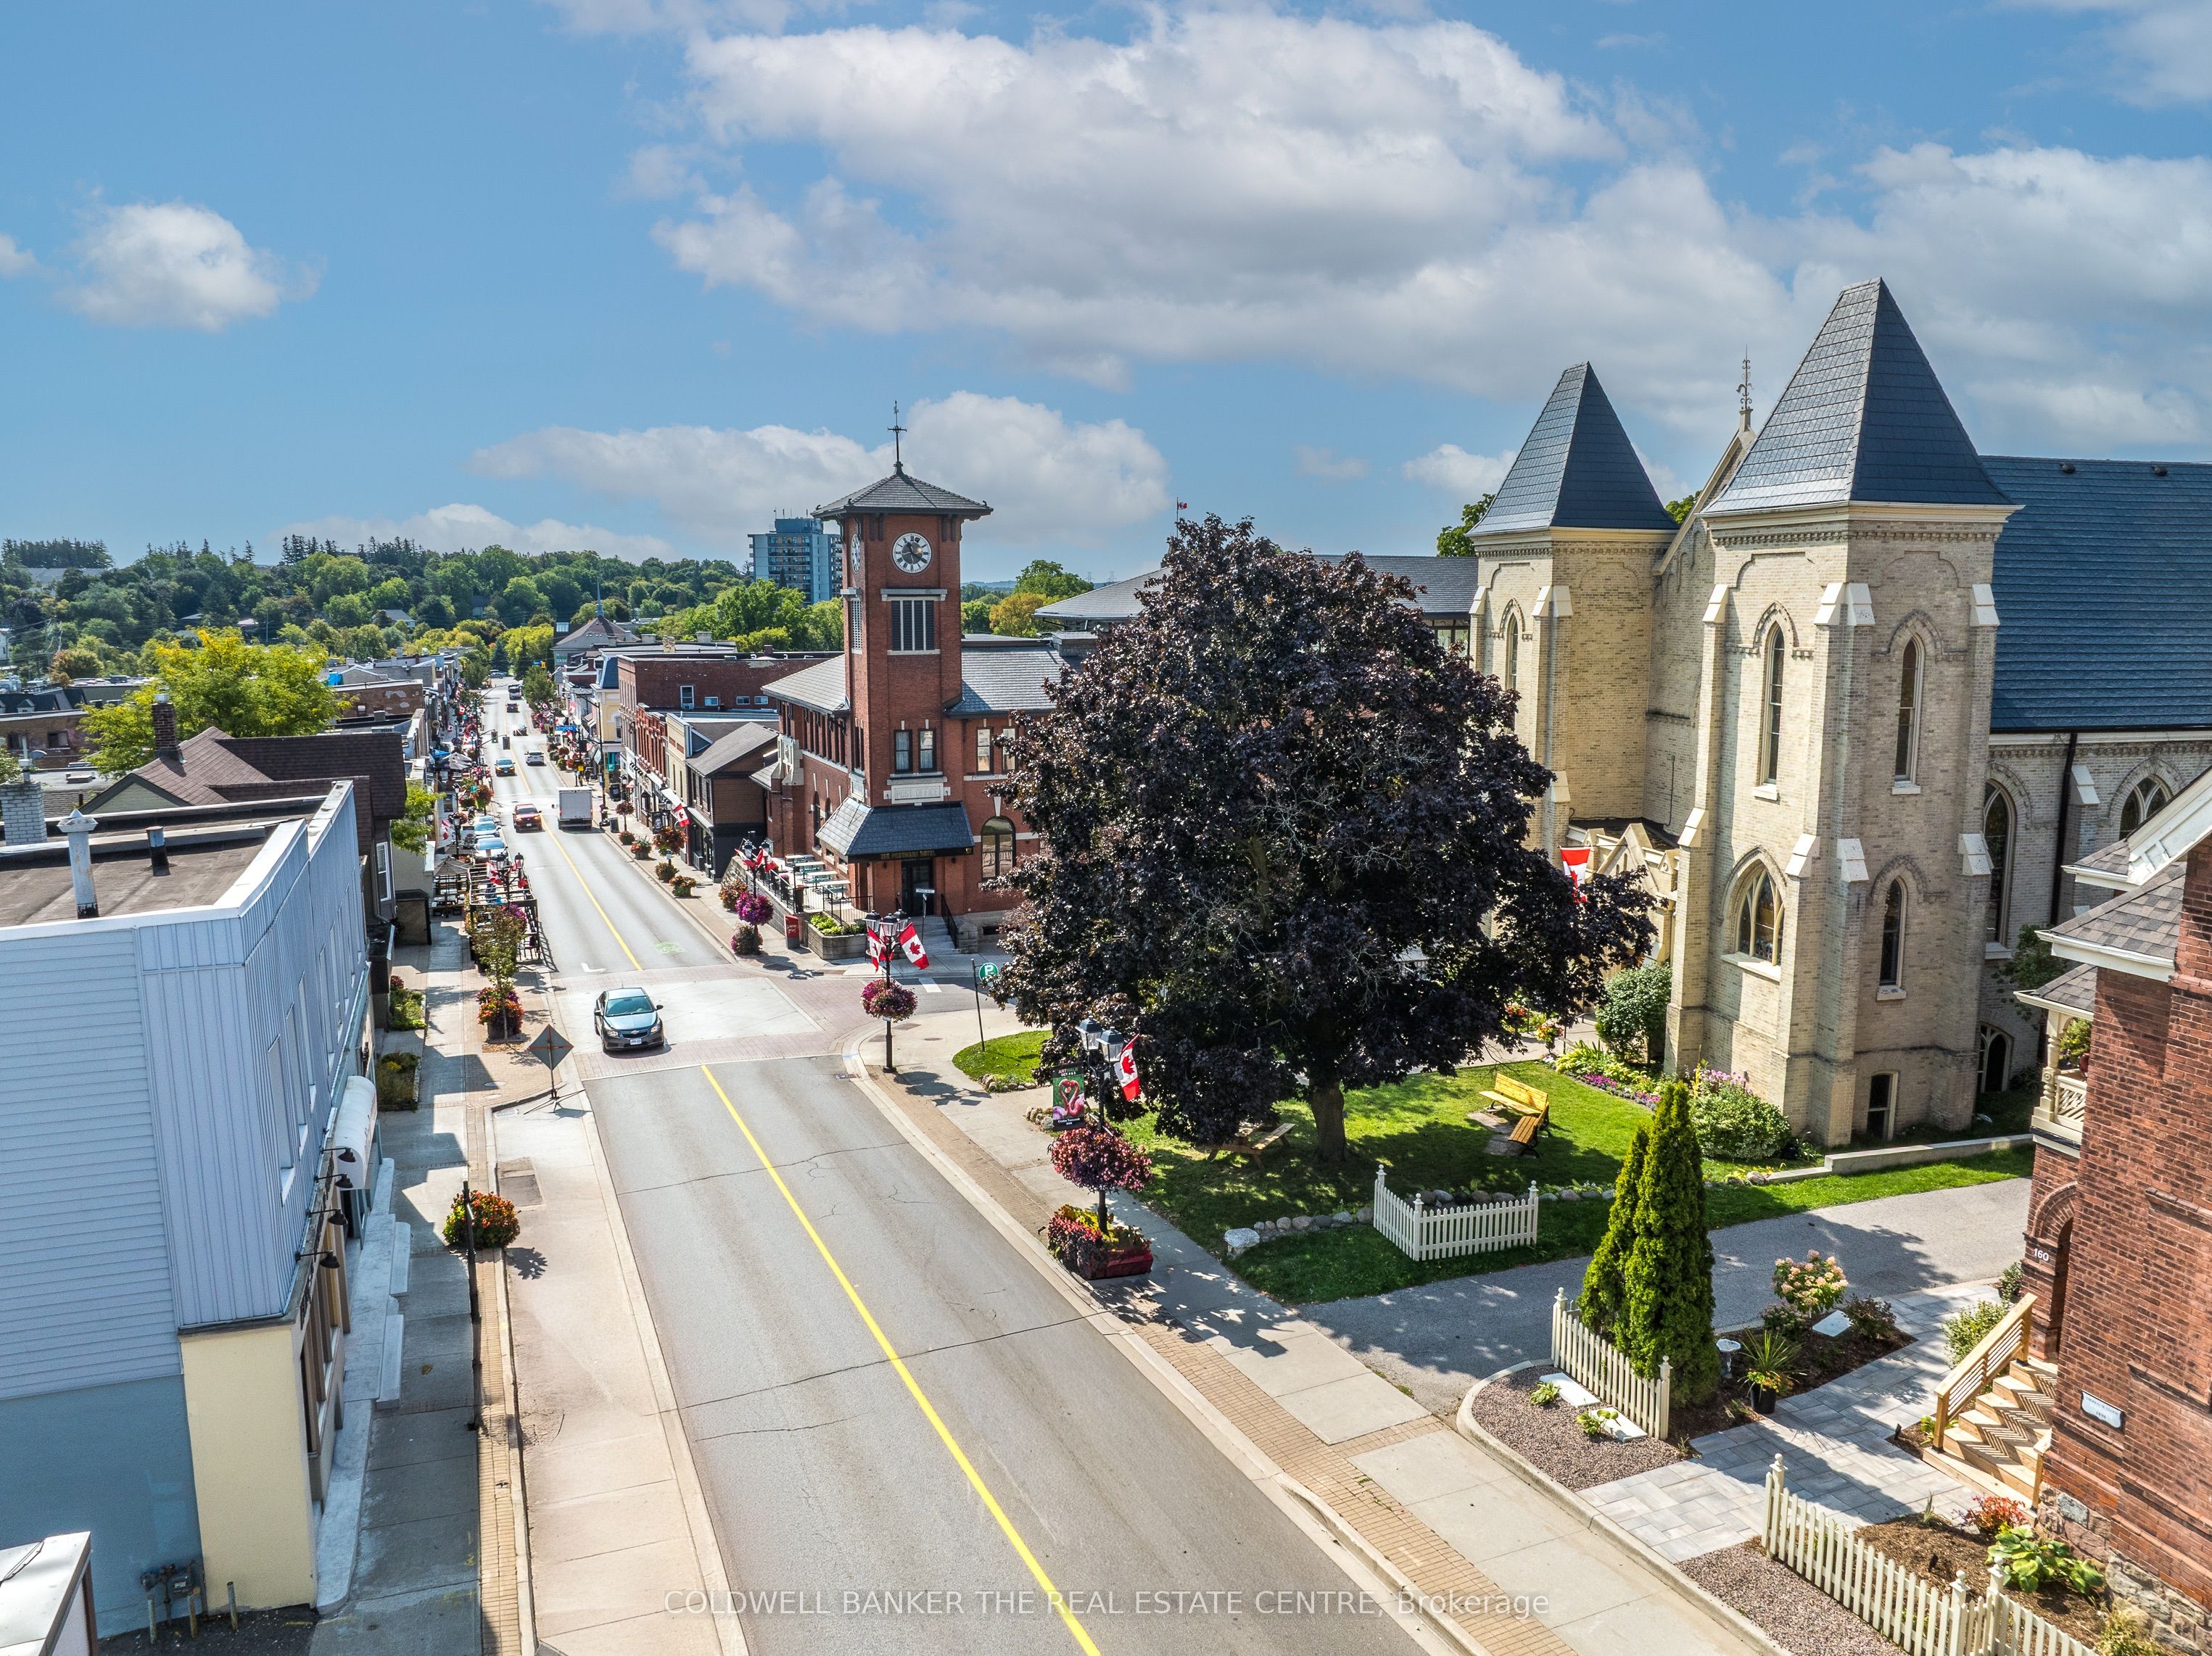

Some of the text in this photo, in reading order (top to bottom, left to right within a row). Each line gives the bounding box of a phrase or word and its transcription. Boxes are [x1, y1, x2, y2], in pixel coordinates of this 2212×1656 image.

[896, 787, 939, 798] POST OFFICE
[984, 964, 994, 976] P
[2034, 1248, 2050, 1262] 160
